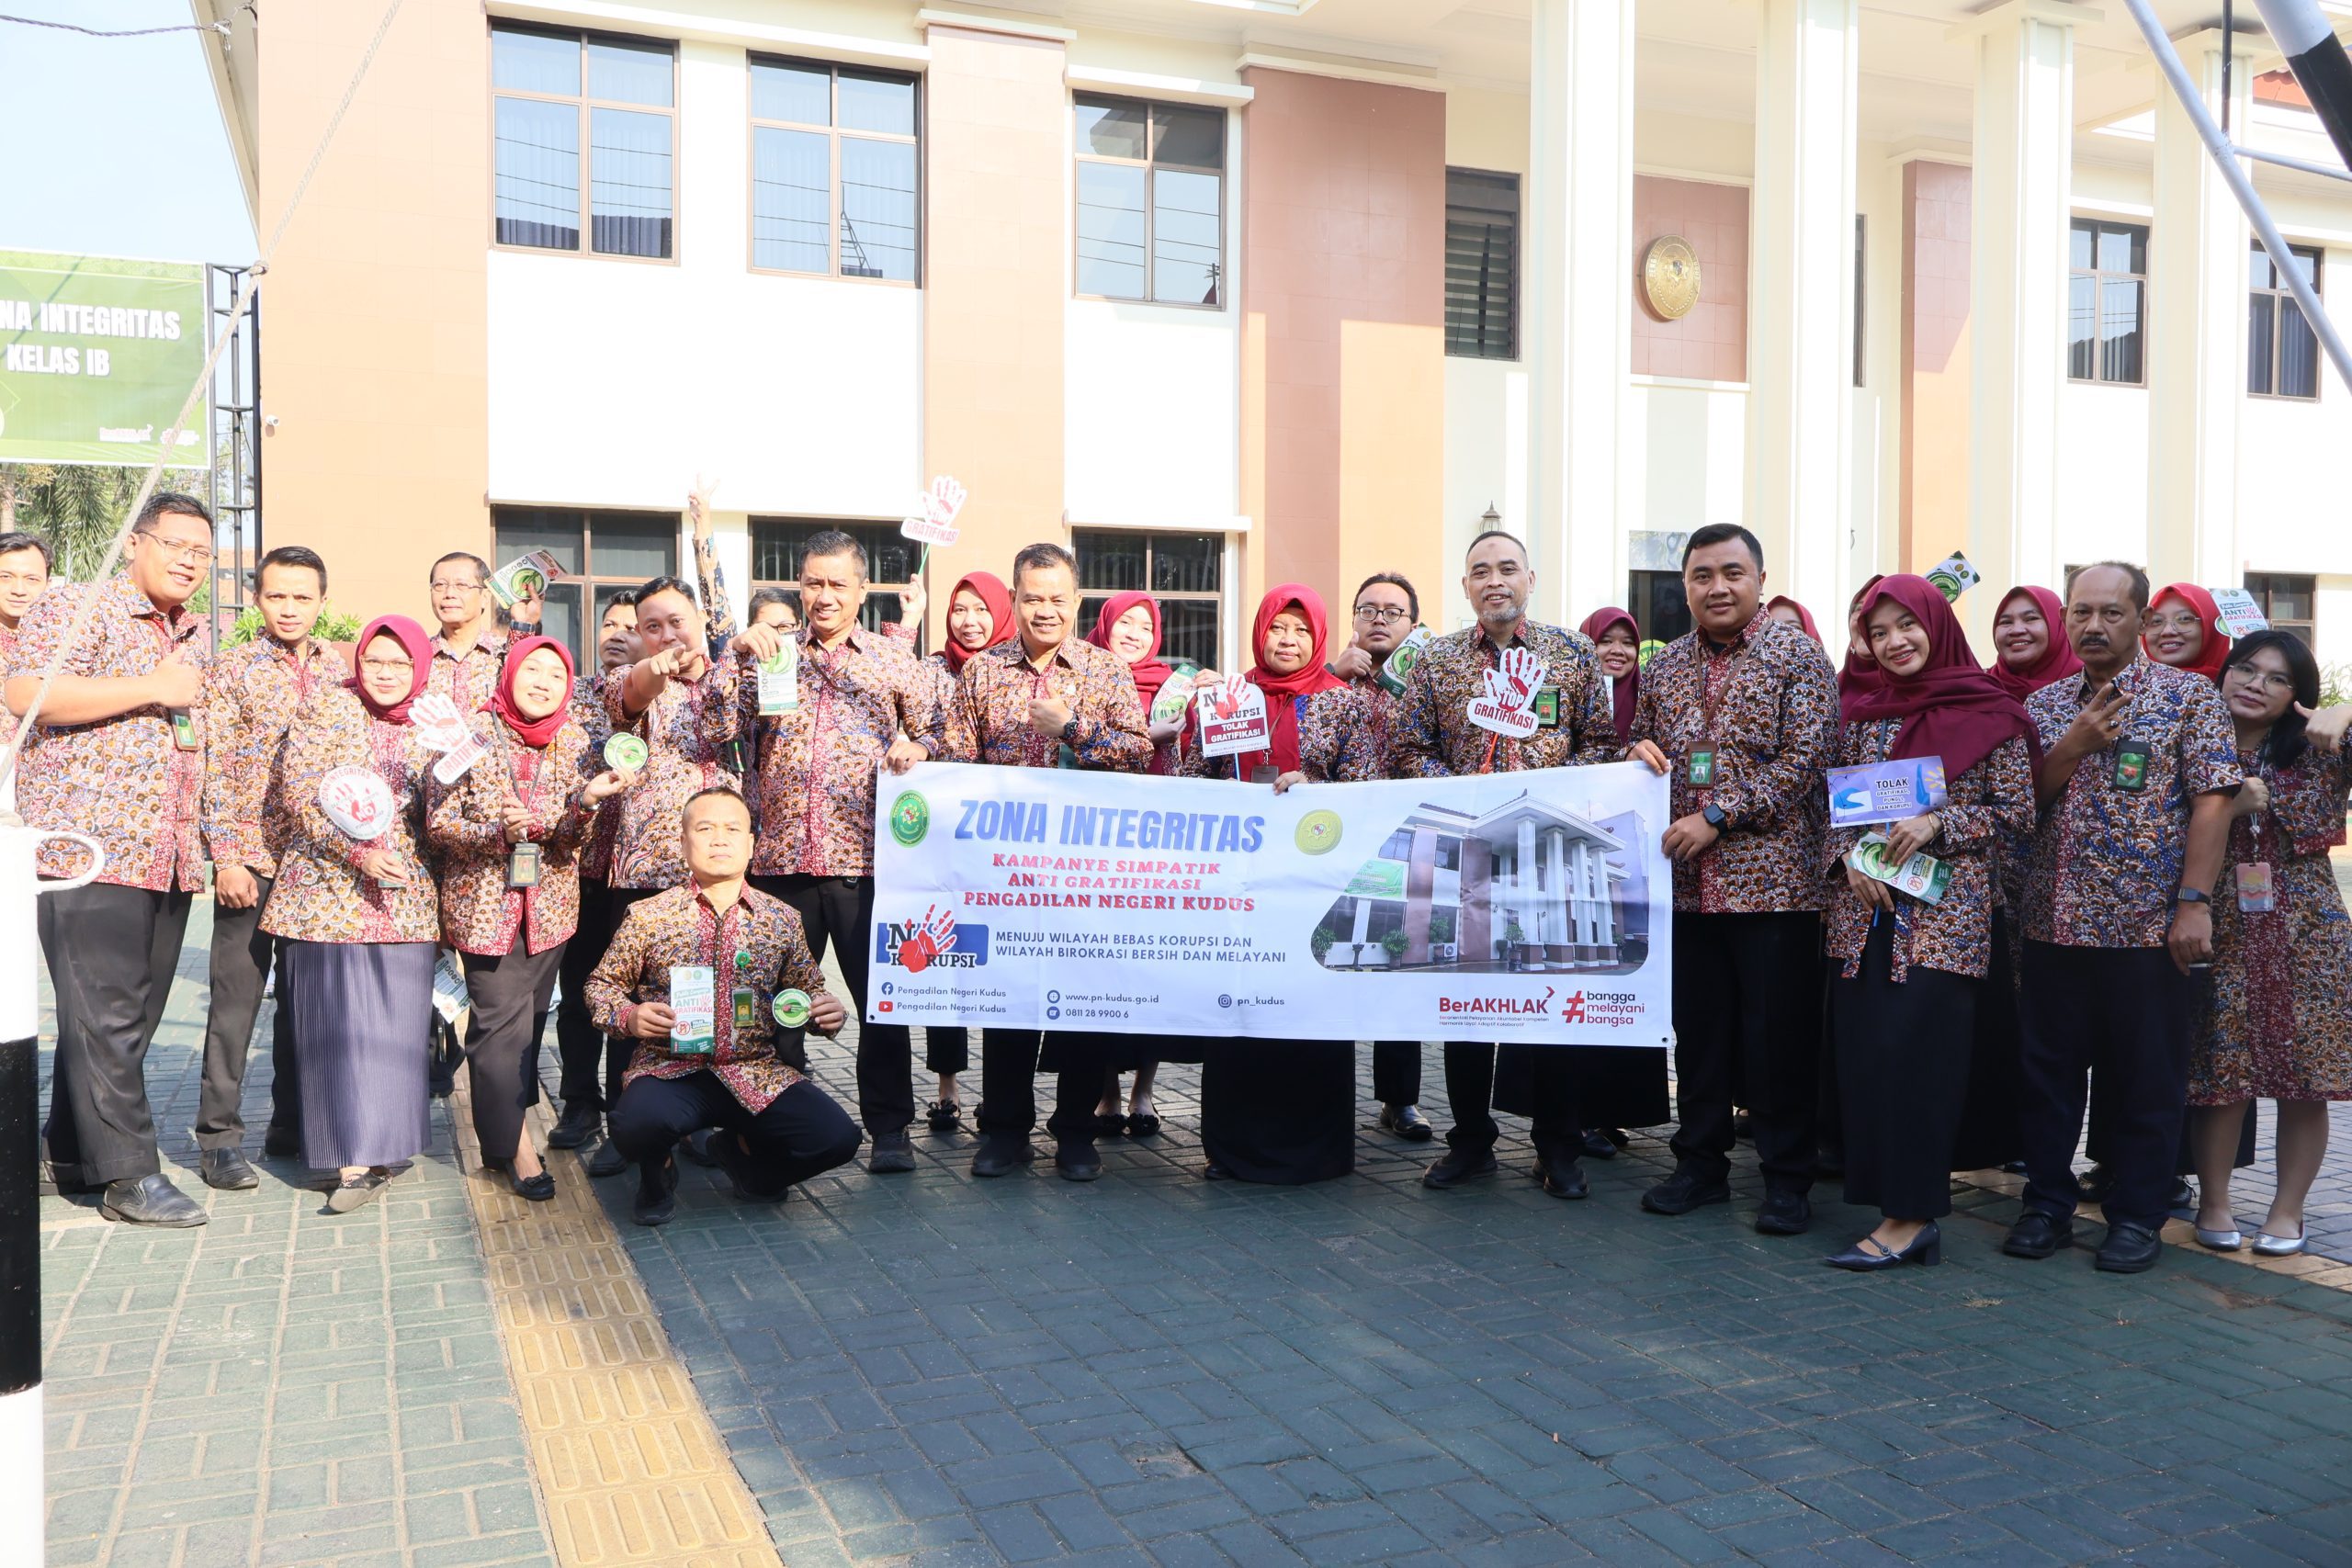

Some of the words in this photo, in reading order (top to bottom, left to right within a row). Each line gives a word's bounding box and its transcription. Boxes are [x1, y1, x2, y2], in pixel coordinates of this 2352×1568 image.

[40, 302, 181, 340] INTEGRITAS
[7, 344, 80, 375] KELAS
[86, 348, 110, 376] IB
[1497, 687, 1525, 709] STOP
[1474, 702, 1534, 730] GRATIFIKASI
[1221, 721, 1250, 732] TOLAK
[1211, 728, 1261, 743] GRATIFIKASI
[1876, 778, 1908, 789] TOLAK
[955, 799, 1047, 843] ZONA
[1059, 805, 1265, 853] INTEGRITAS
[992, 853, 1109, 872] KAMPANYE
[1115, 860, 1221, 874] SIMPATIK
[1008, 873, 1058, 887] ANTI
[1065, 875, 1202, 890] GRATIFIKASI
[964, 892, 1091, 908] PENGADILAN
[1098, 895, 1175, 910] NEGERI
[1182, 897, 1255, 912] KUDUS
[996, 931, 1045, 942] MENUJU
[1050, 933, 1108, 944] WILAYAH
[1113, 934, 1154, 946] BEBAS
[1159, 935, 1218, 947] KORUPSI
[1223, 936, 1251, 948] DAN
[996, 946, 1054, 957] WILAYAH
[1058, 948, 1127, 959] BIROKRASI
[1132, 949, 1178, 960] BERSIH
[1183, 950, 1211, 961] DAN
[1216, 951, 1286, 962] MELAYANI
[898, 987, 948, 996] Pengadilan
[950, 987, 978, 998] Negeri
[980, 989, 1006, 997] Kudus
[1065, 993, 1159, 1005] www.pn-kudus.go.id
[1587, 991, 1635, 1004] bangga
[675, 998, 699, 1008] ANTI
[897, 1002, 947, 1012] Pengadilan
[950, 1004, 978, 1013] Negeri
[980, 1004, 1006, 1013] Kudus
[1238, 996, 1285, 1006] pn_kudus
[1439, 997, 1549, 1014] BerAKHLAK
[675, 1006, 713, 1015] GRATIFIKASI
[1066, 1009, 1083, 1017] 0811
[1085, 1009, 1096, 1017] 28
[1099, 1010, 1121, 1018] 9900
[1587, 1003, 1645, 1015] melayani
[1587, 1014, 1634, 1027] bangsa
